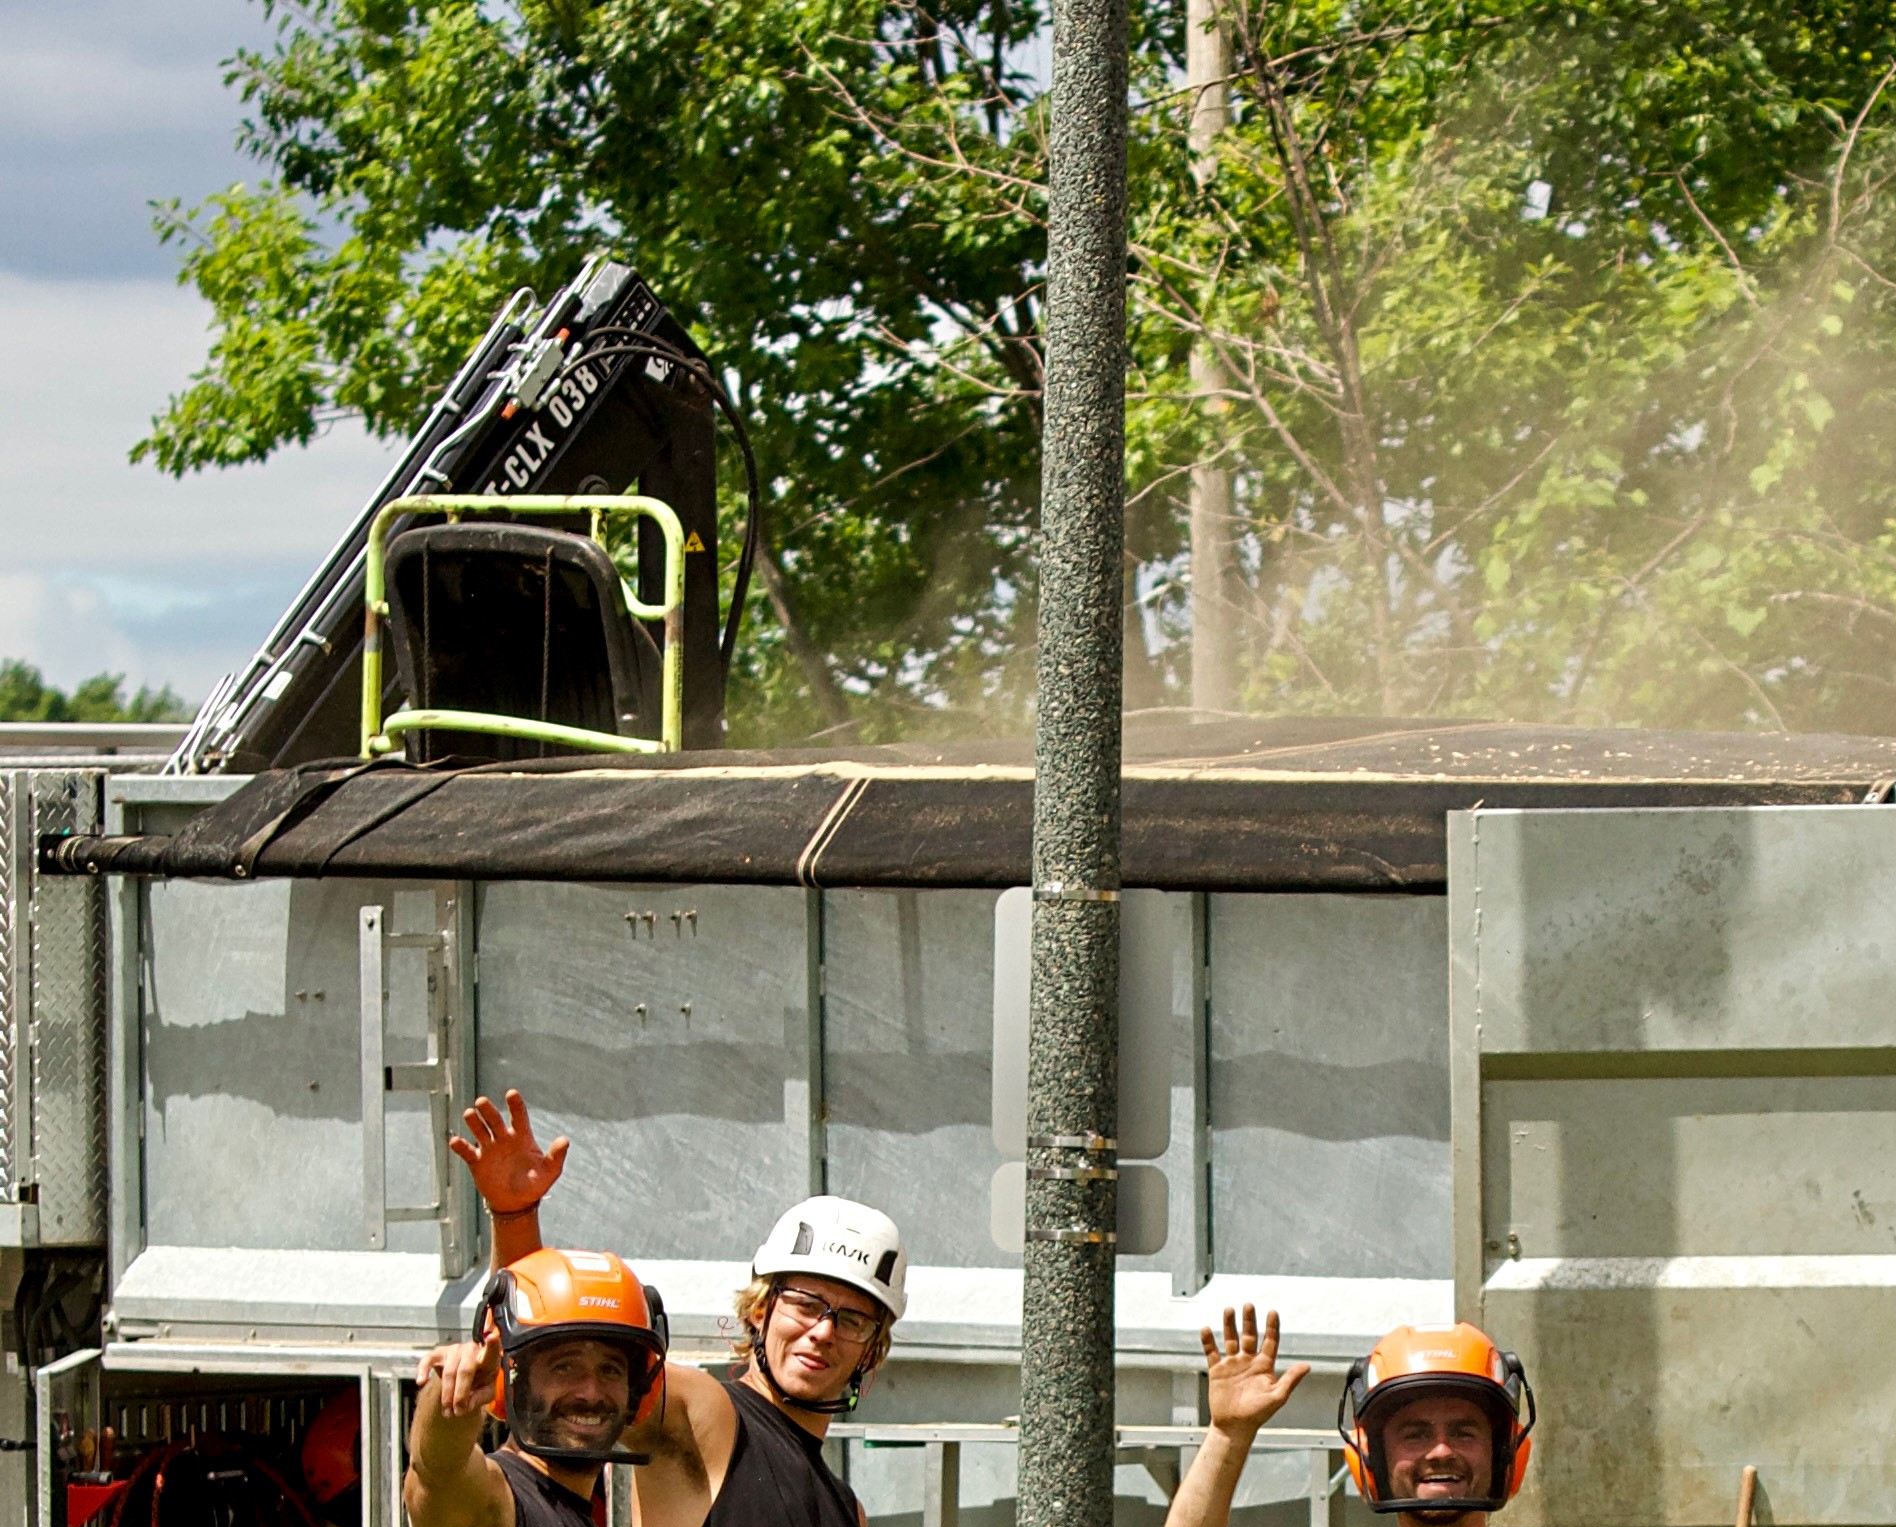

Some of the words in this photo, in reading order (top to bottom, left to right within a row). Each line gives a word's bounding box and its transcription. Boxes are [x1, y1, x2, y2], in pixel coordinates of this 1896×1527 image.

[549, 364, 599, 428] 038
[822, 1242, 870, 1265] KASK
[579, 1296, 620, 1309] STIHL
